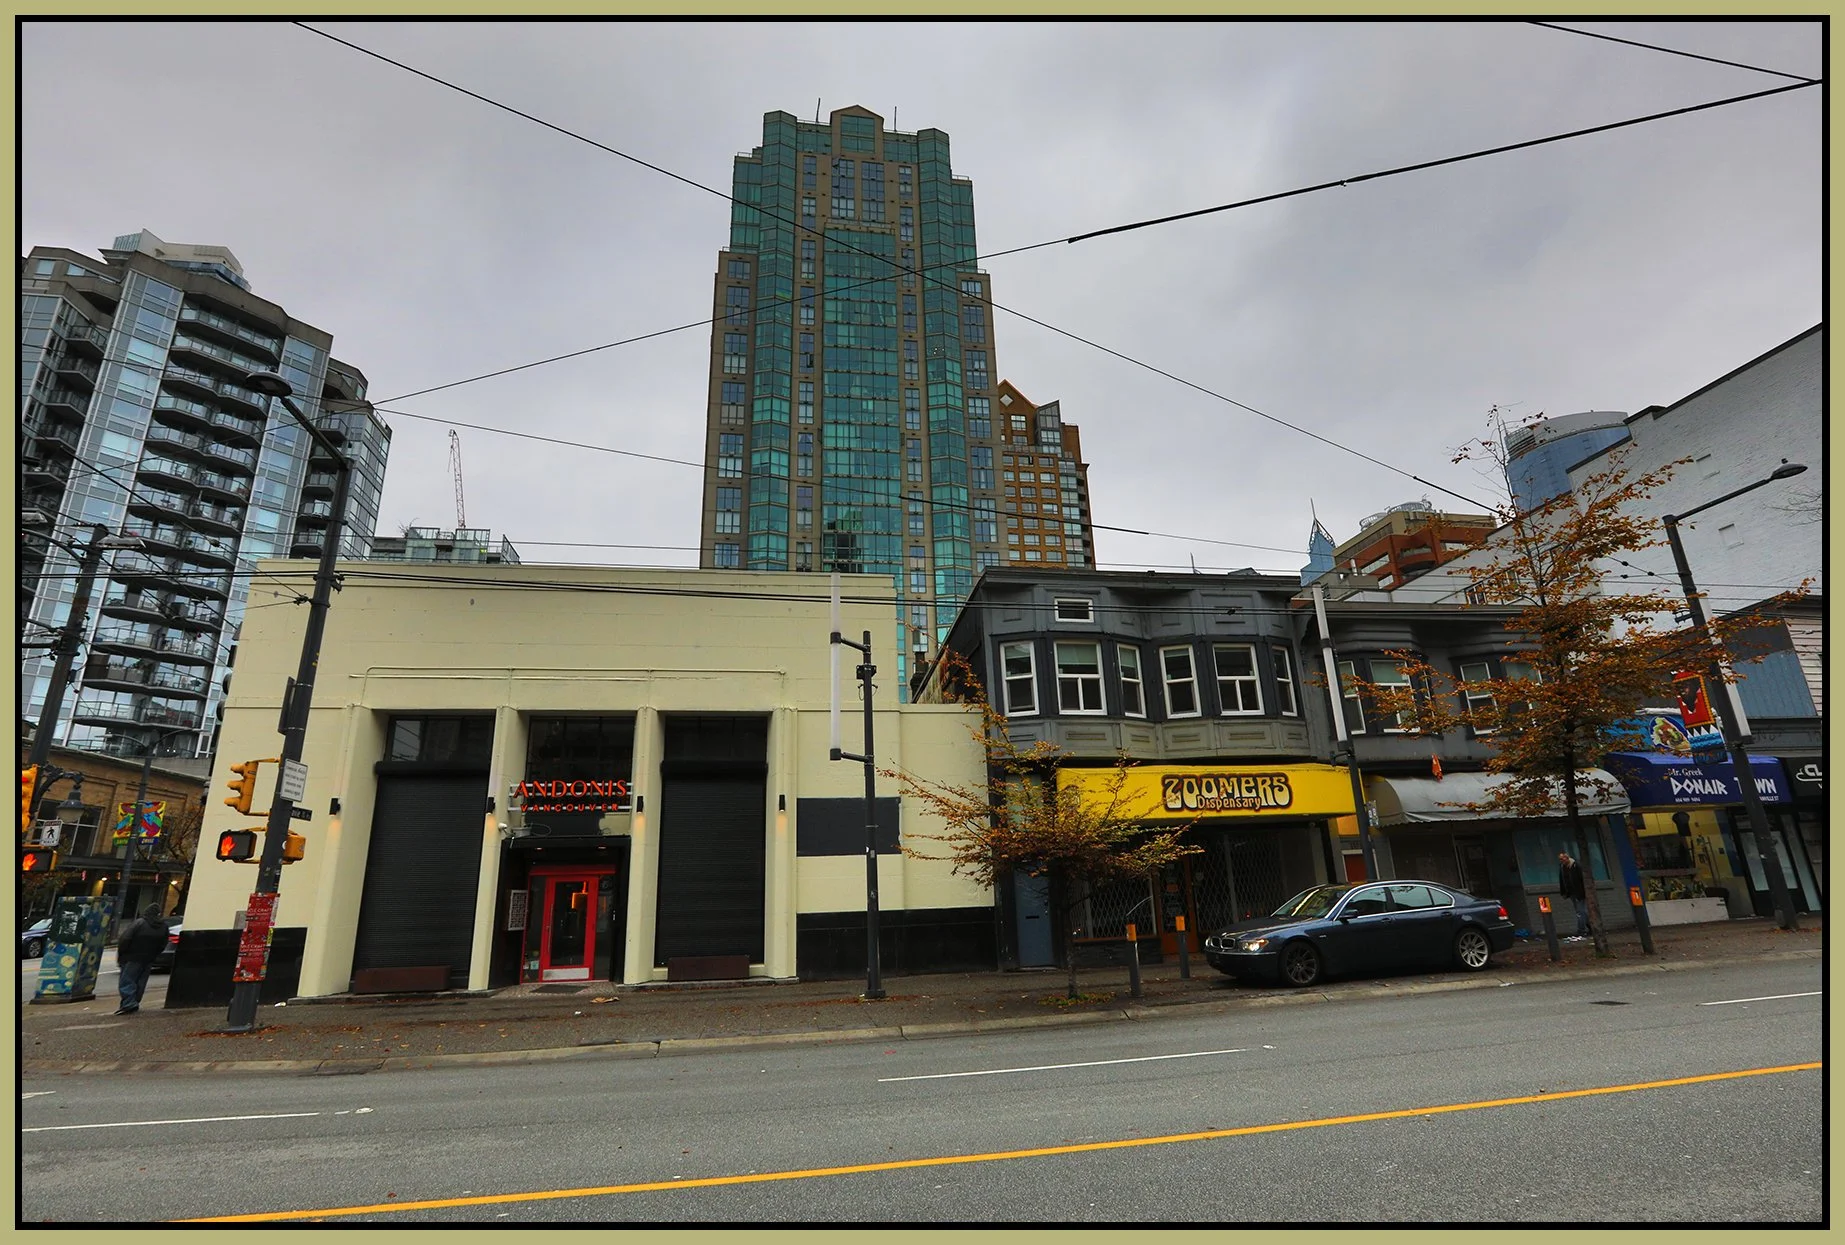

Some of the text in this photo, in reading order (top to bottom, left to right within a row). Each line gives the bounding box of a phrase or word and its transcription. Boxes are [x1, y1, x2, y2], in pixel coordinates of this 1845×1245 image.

[1682, 767, 1704, 777] Greek
[513, 779, 628, 798] ANDONIS
[1164, 777, 1290, 809] ZOOMERS
[1670, 776, 1778, 795] DONAIR TWN
[520, 803, 619, 812] VANCOUVER
[1197, 794, 1263, 811] Dispensary
